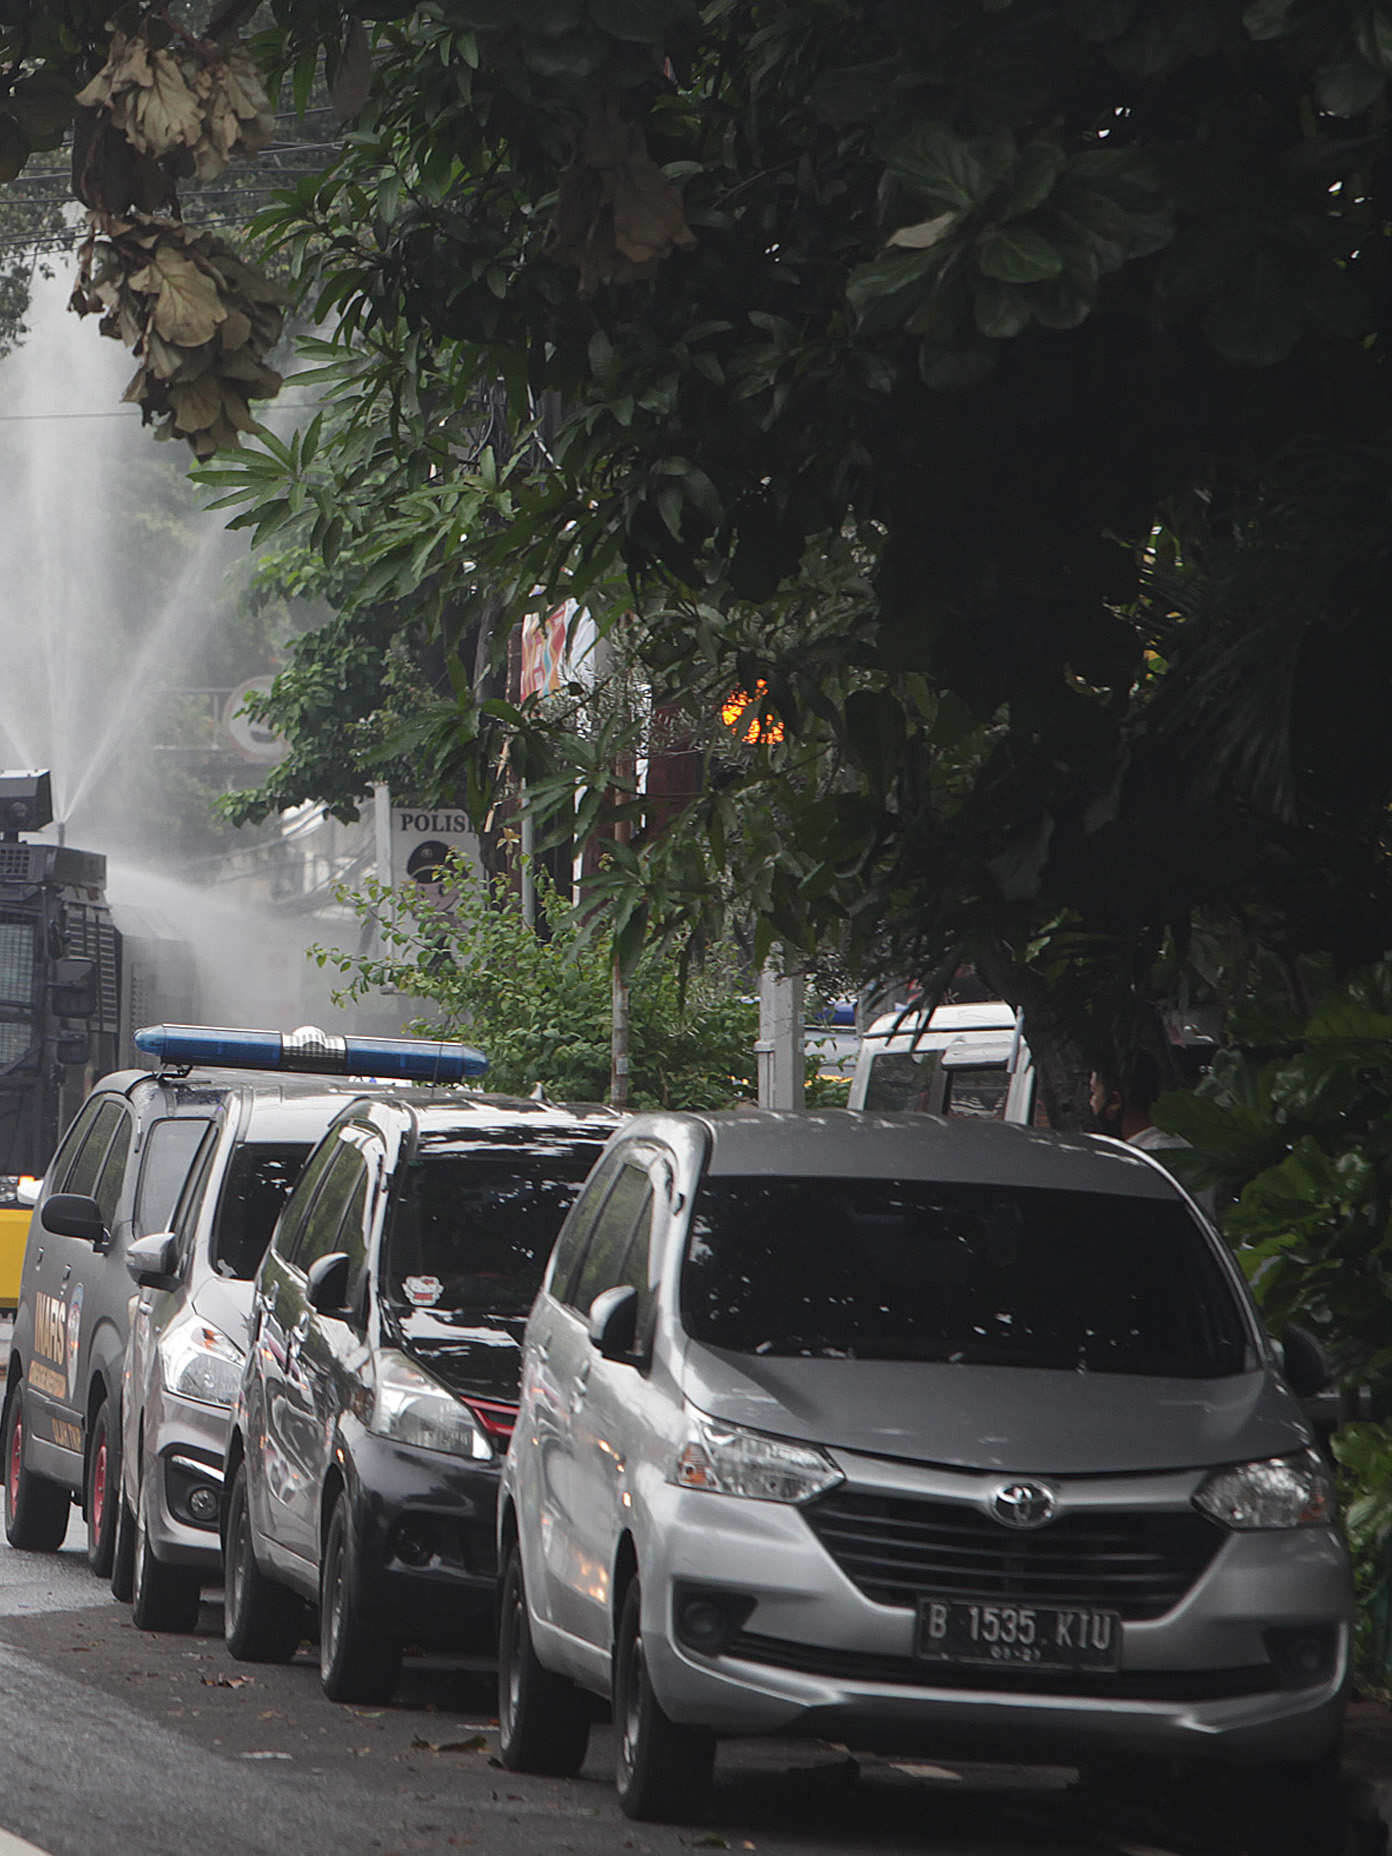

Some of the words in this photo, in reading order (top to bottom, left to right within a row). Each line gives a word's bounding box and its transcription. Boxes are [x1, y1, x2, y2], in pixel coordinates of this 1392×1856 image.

[401, 813, 473, 833] POLISI
[928, 1603, 947, 1639] B
[968, 1606, 1036, 1645] 1535
